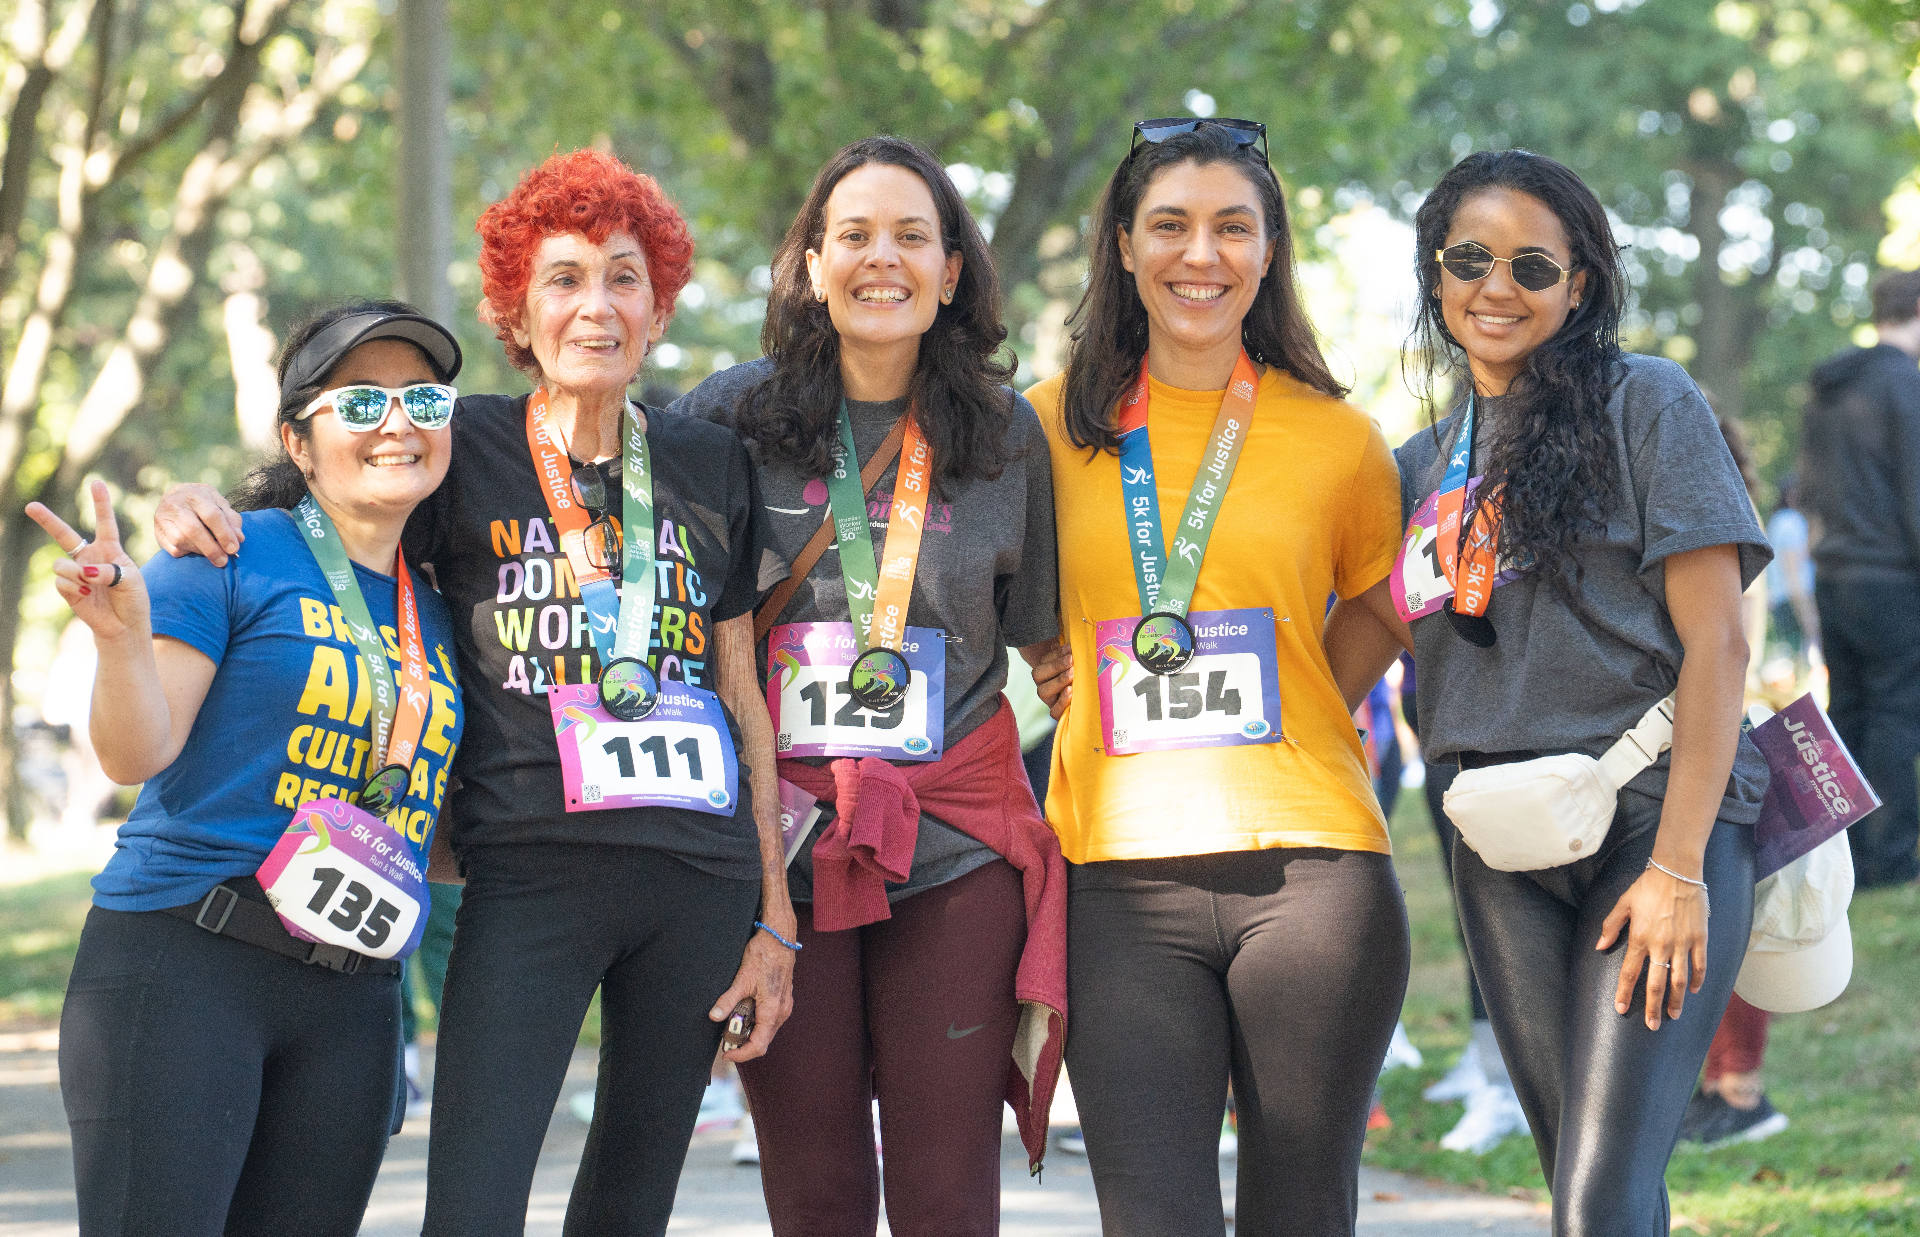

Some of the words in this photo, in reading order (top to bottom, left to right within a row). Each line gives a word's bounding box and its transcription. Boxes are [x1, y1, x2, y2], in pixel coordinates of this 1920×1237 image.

[532, 403, 547, 425] 5k
[534, 422, 552, 446] for
[628, 427, 643, 453] for
[909, 438, 927, 466] for
[1207, 418, 1240, 480] Justice
[629, 453, 645, 477] 5k
[540, 450, 571, 510] Justice
[905, 467, 923, 492] 5k
[1195, 480, 1218, 506] for
[1132, 496, 1150, 518] 5k
[1187, 508, 1209, 530] 5k
[841, 532, 856, 542] 30
[1136, 520, 1153, 546] for
[898, 557, 913, 567] 30
[1469, 561, 1487, 587] 5k
[496, 557, 707, 607] DOMTIC
[403, 585, 418, 640] Justice
[1170, 599, 1185, 608] 30
[1465, 588, 1484, 616] for
[494, 604, 706, 655] WORERS
[622, 594, 647, 659] Justice
[878, 604, 899, 650] stice
[1144, 624, 1158, 634] 5k
[1194, 621, 1248, 638] Justice
[406, 638, 420, 663] for
[834, 634, 857, 650] for
[1196, 641, 1218, 650] Walk
[368, 653, 383, 676] 5k
[841, 652, 858, 661] Run
[861, 659, 874, 669] 5k
[408, 662, 424, 681] 5k
[502, 654, 705, 695] ALLICE
[609, 670, 622, 680] 5k
[376, 678, 390, 708] for
[657, 692, 705, 710] Justice
[1133, 670, 1242, 722] 154
[655, 708, 662, 716] &
[662, 708, 683, 717] Walk
[378, 709, 392, 769] Justic
[1808, 731, 1824, 757] SOCIAL
[287, 724, 429, 801] CULTA
[602, 735, 704, 782] 111
[1783, 716, 1851, 815] Justice
[1810, 779, 1838, 820] magazine
[350, 823, 373, 845] 5k
[370, 836, 393, 857] for
[389, 850, 423, 884] Justice
[369, 854, 384, 869] Run
[382, 863, 390, 873] &
[388, 866, 405, 883] Walk
[306, 867, 401, 949] 135
